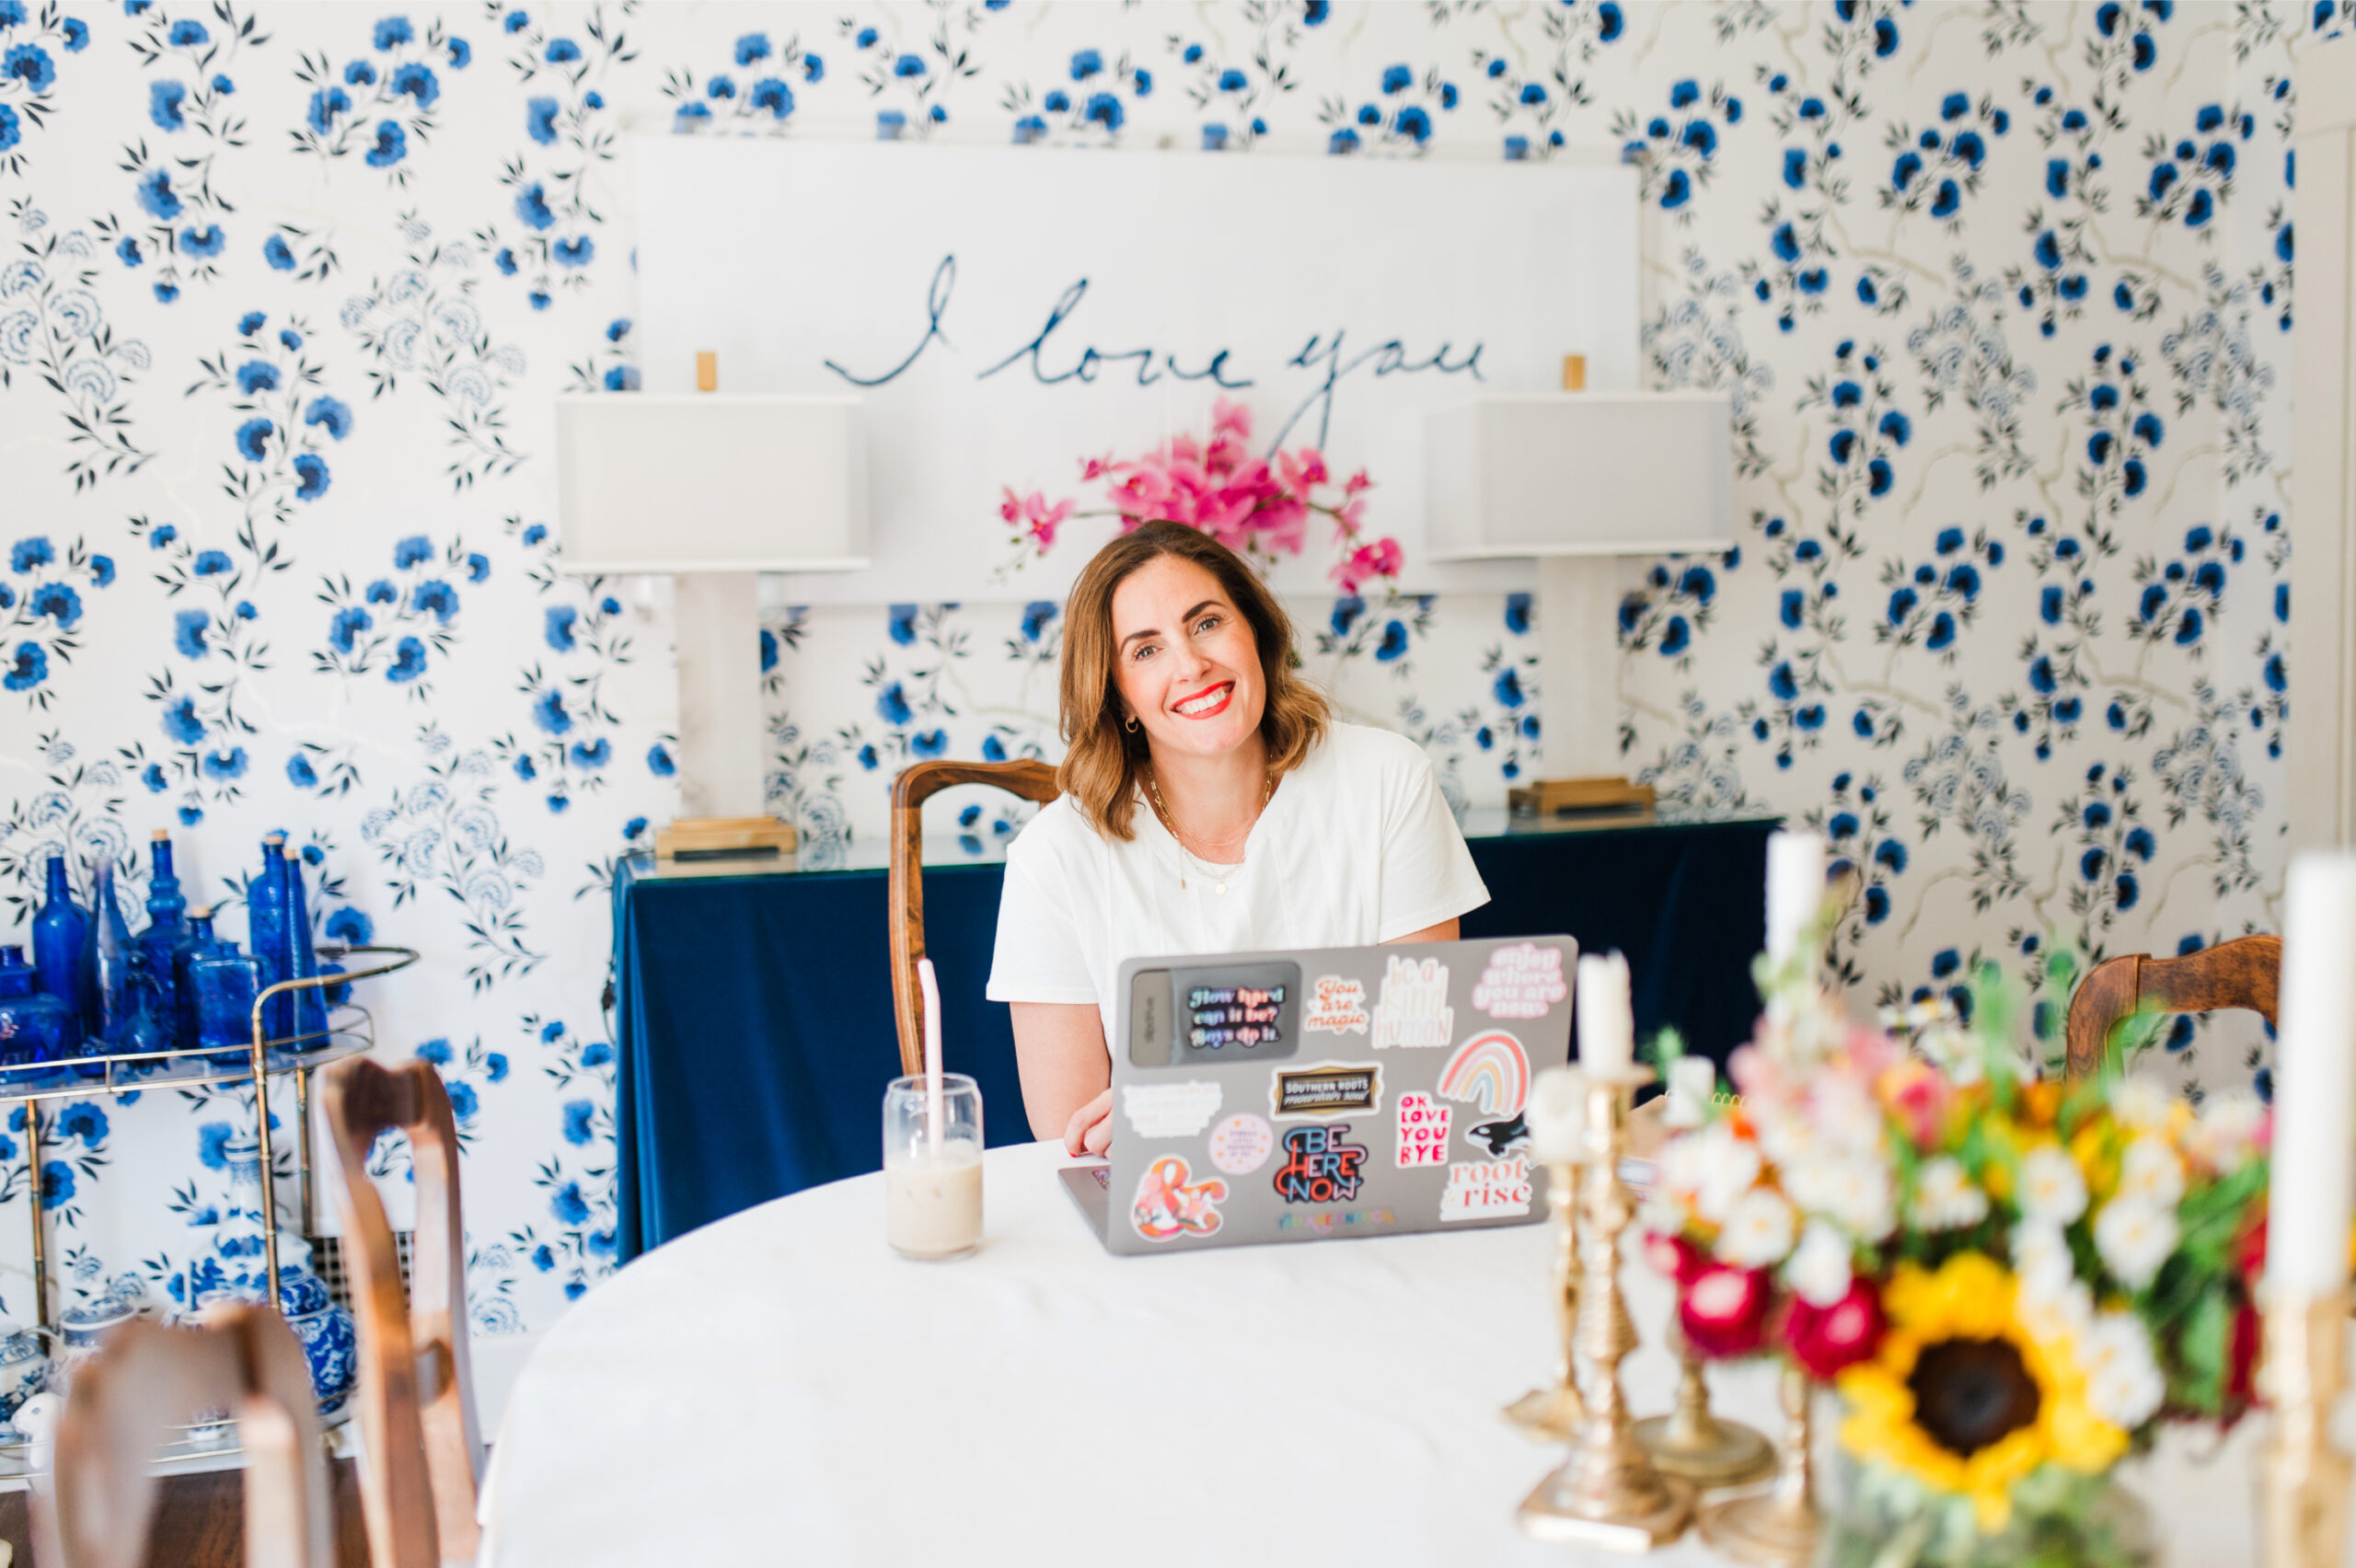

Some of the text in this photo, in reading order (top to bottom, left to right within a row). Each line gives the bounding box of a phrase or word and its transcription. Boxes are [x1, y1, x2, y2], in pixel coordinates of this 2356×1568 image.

[825, 254, 1486, 459] I love you
[1494, 942, 1561, 971] enjoy
[1318, 980, 1358, 1000] You
[1475, 985, 1565, 1008] you are
[1322, 999, 1353, 1012] are
[1307, 1010, 1366, 1031] magic
[1285, 1077, 1369, 1094] SOUTHERN ROOTS
[1283, 1090, 1370, 1105] mountain soul
[1401, 1096, 1426, 1109] OK
[1401, 1110, 1449, 1124] LOVE
[1284, 1124, 1369, 1165] BE
[1401, 1127, 1447, 1142] YOU
[1401, 1145, 1445, 1165] BYE
[1453, 1158, 1525, 1184] root
[1288, 1176, 1357, 1202] NOW
[1464, 1182, 1530, 1206] rise
